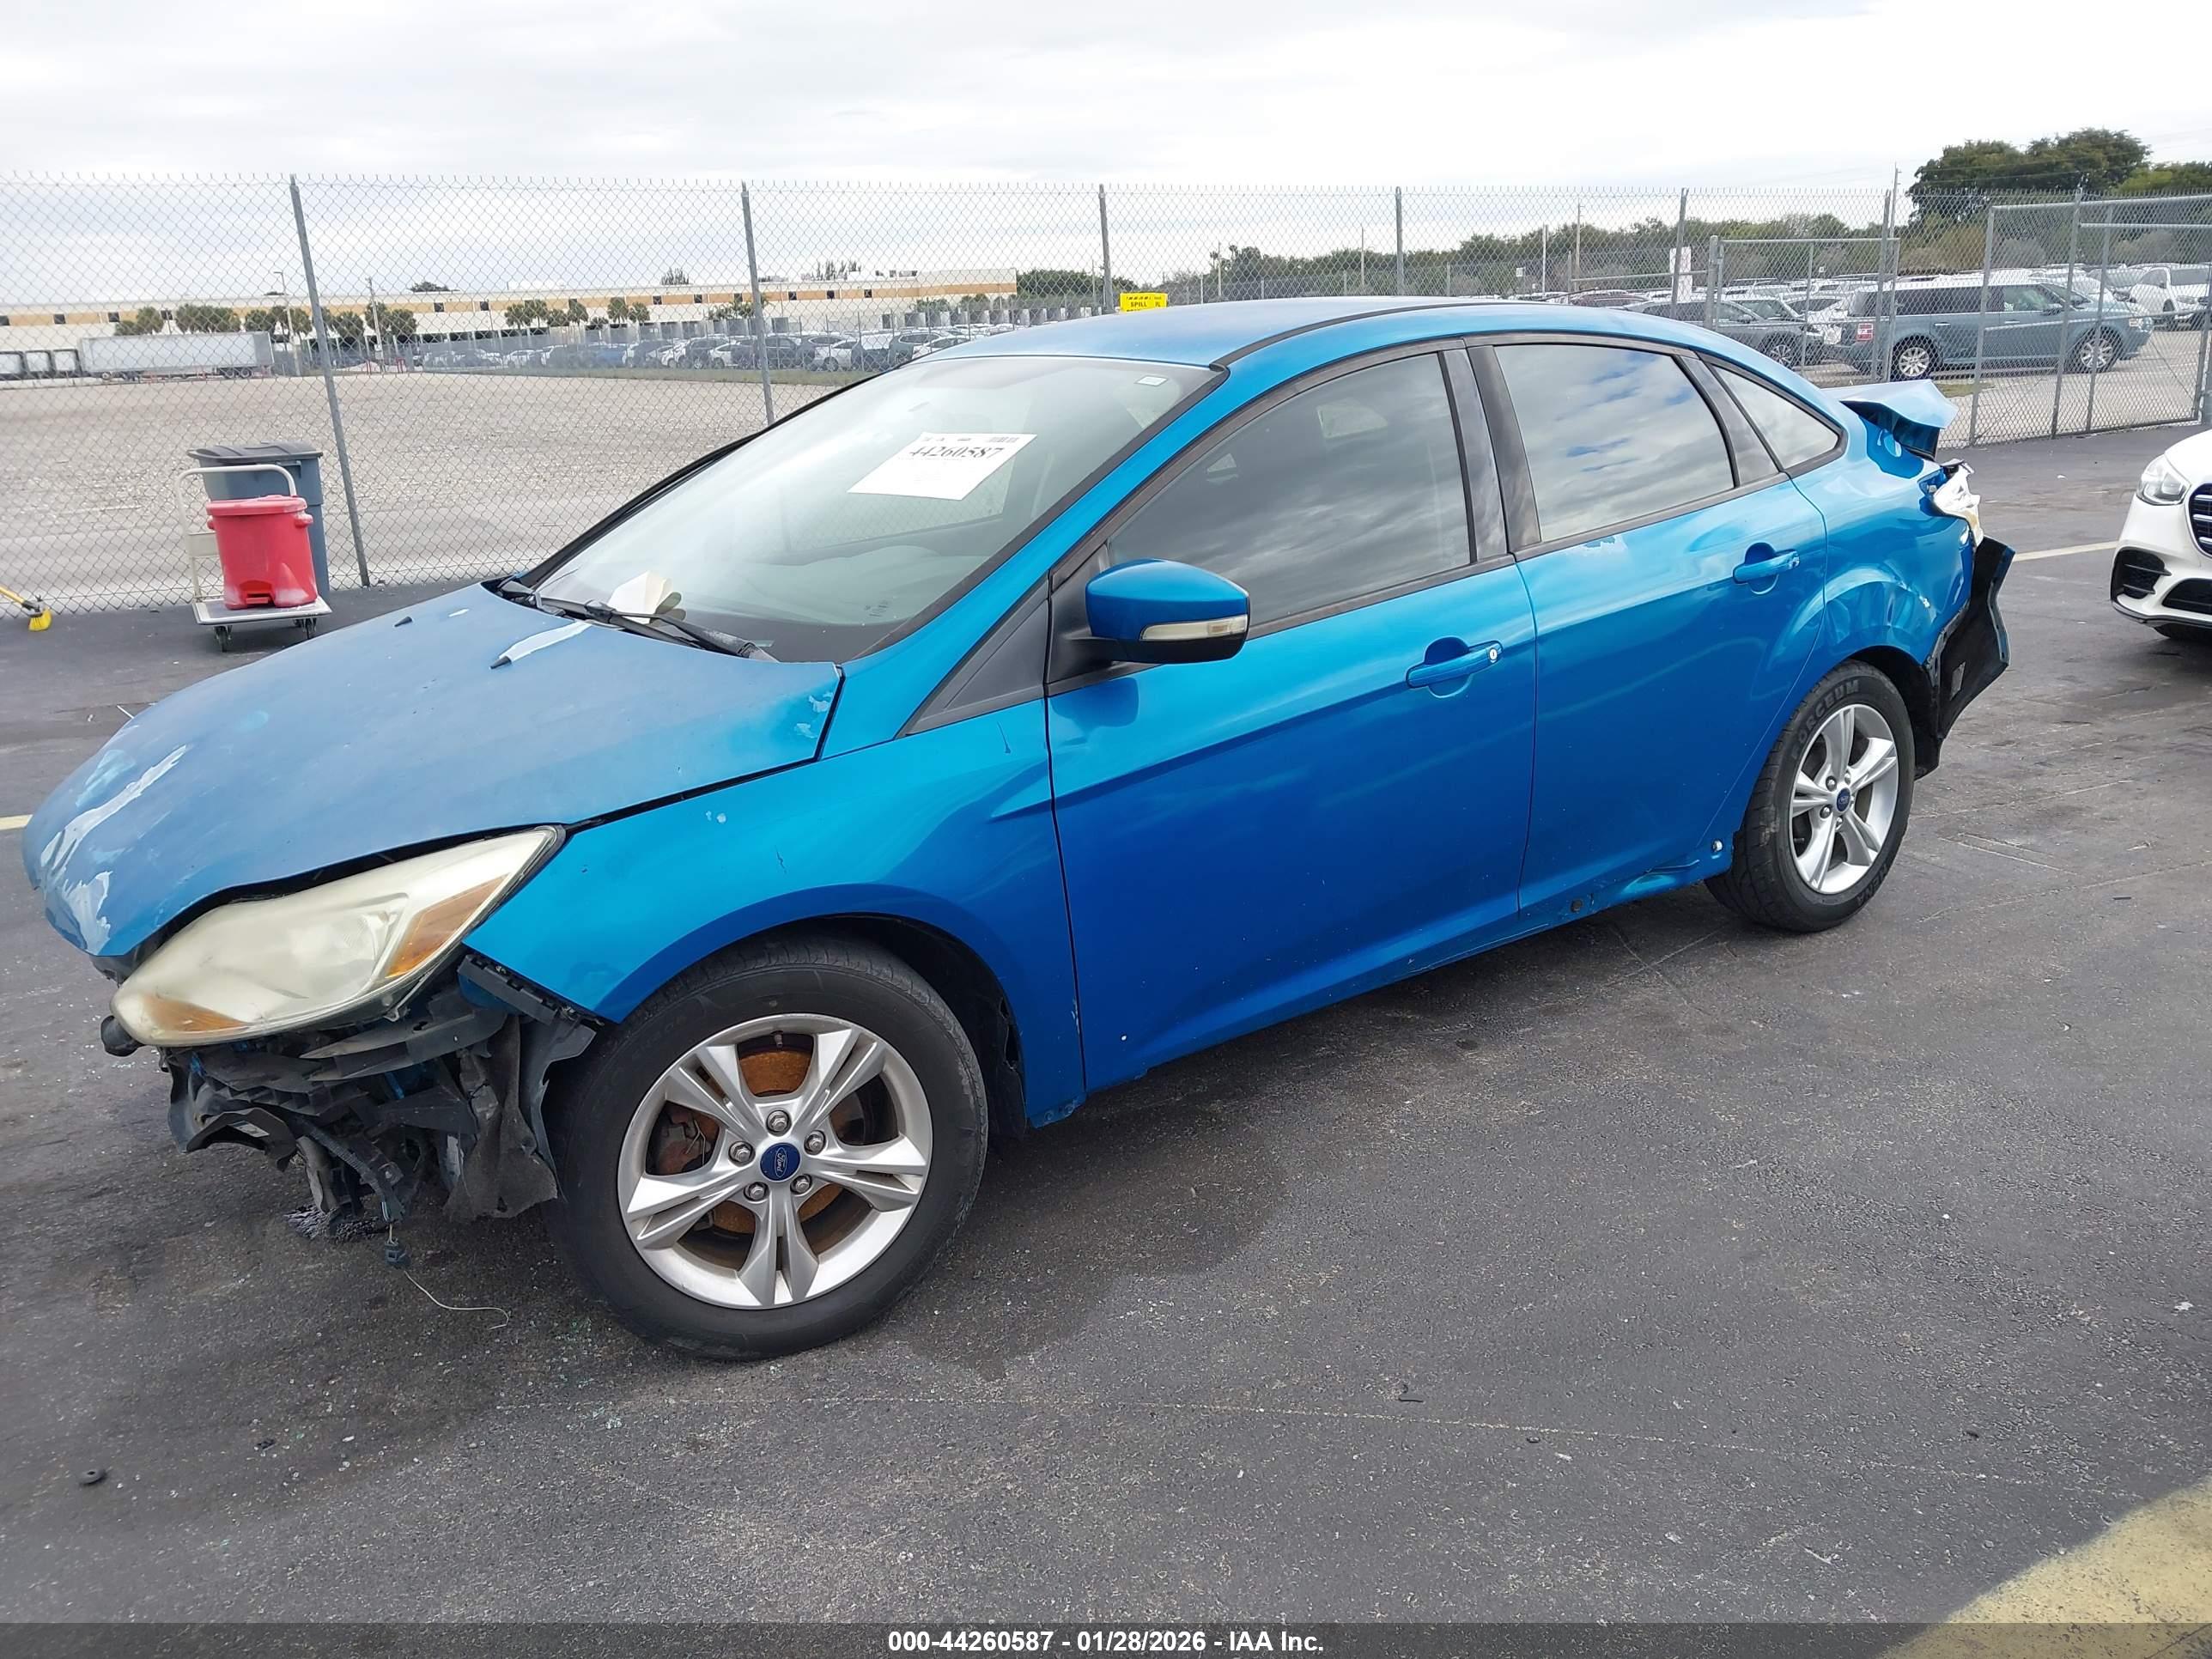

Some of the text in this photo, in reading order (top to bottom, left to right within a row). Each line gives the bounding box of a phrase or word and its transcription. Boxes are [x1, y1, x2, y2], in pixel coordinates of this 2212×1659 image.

[909, 446, 1005, 459] 44260587
[1791, 679, 1859, 760] FORCEUM
[776, 1152, 786, 1172] Ford
